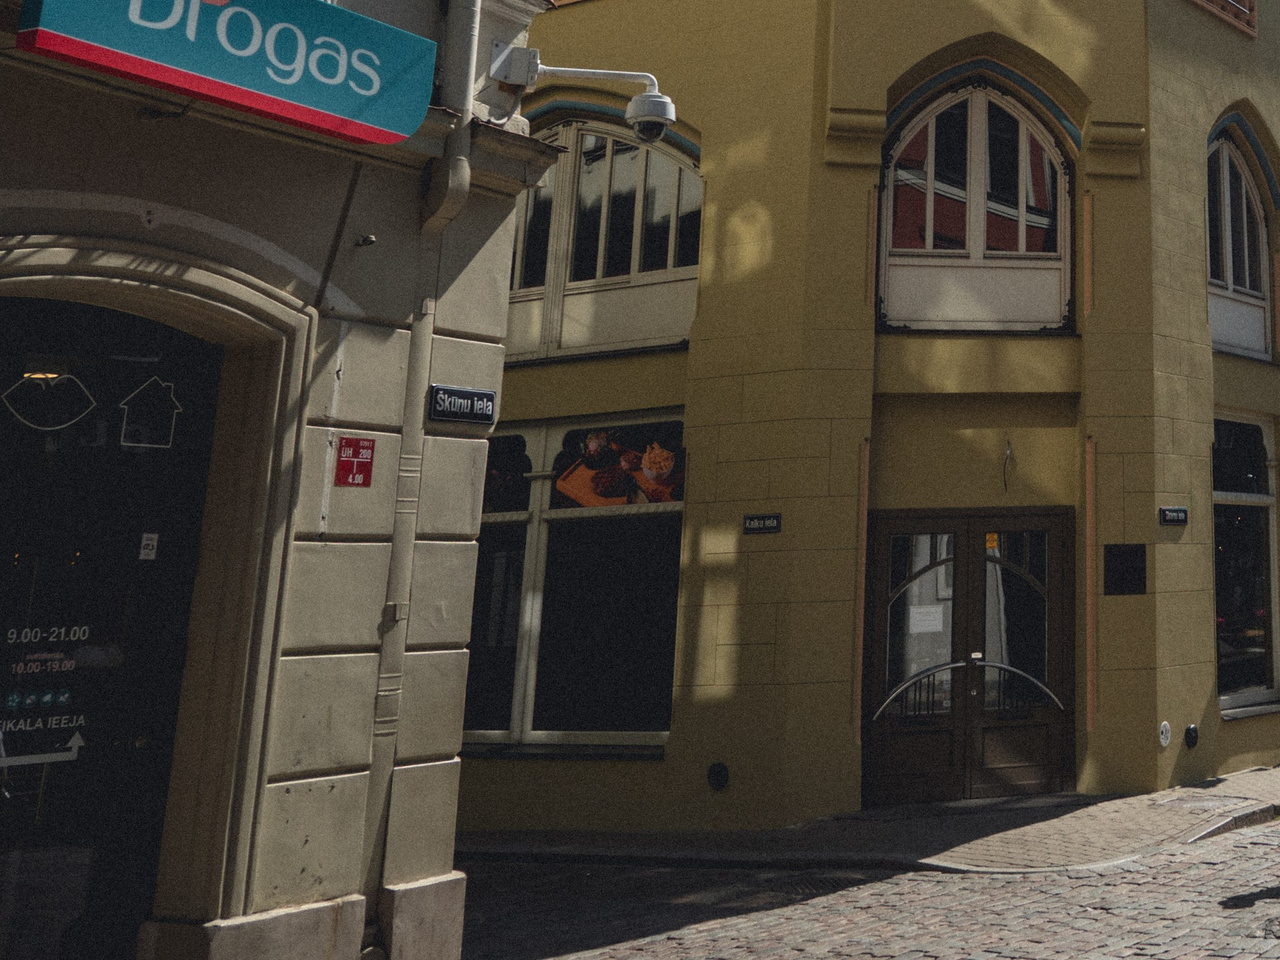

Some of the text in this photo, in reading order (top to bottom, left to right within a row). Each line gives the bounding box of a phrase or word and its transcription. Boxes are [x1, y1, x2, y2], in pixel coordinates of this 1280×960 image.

[473, 397, 493, 415] iela
[341, 447, 353, 458] UH
[7, 626, 89, 643] 9.00-21.00
[11, 660, 77, 674] 10.00-19.00
[0, 715, 86, 733] IKALA IEEJA
